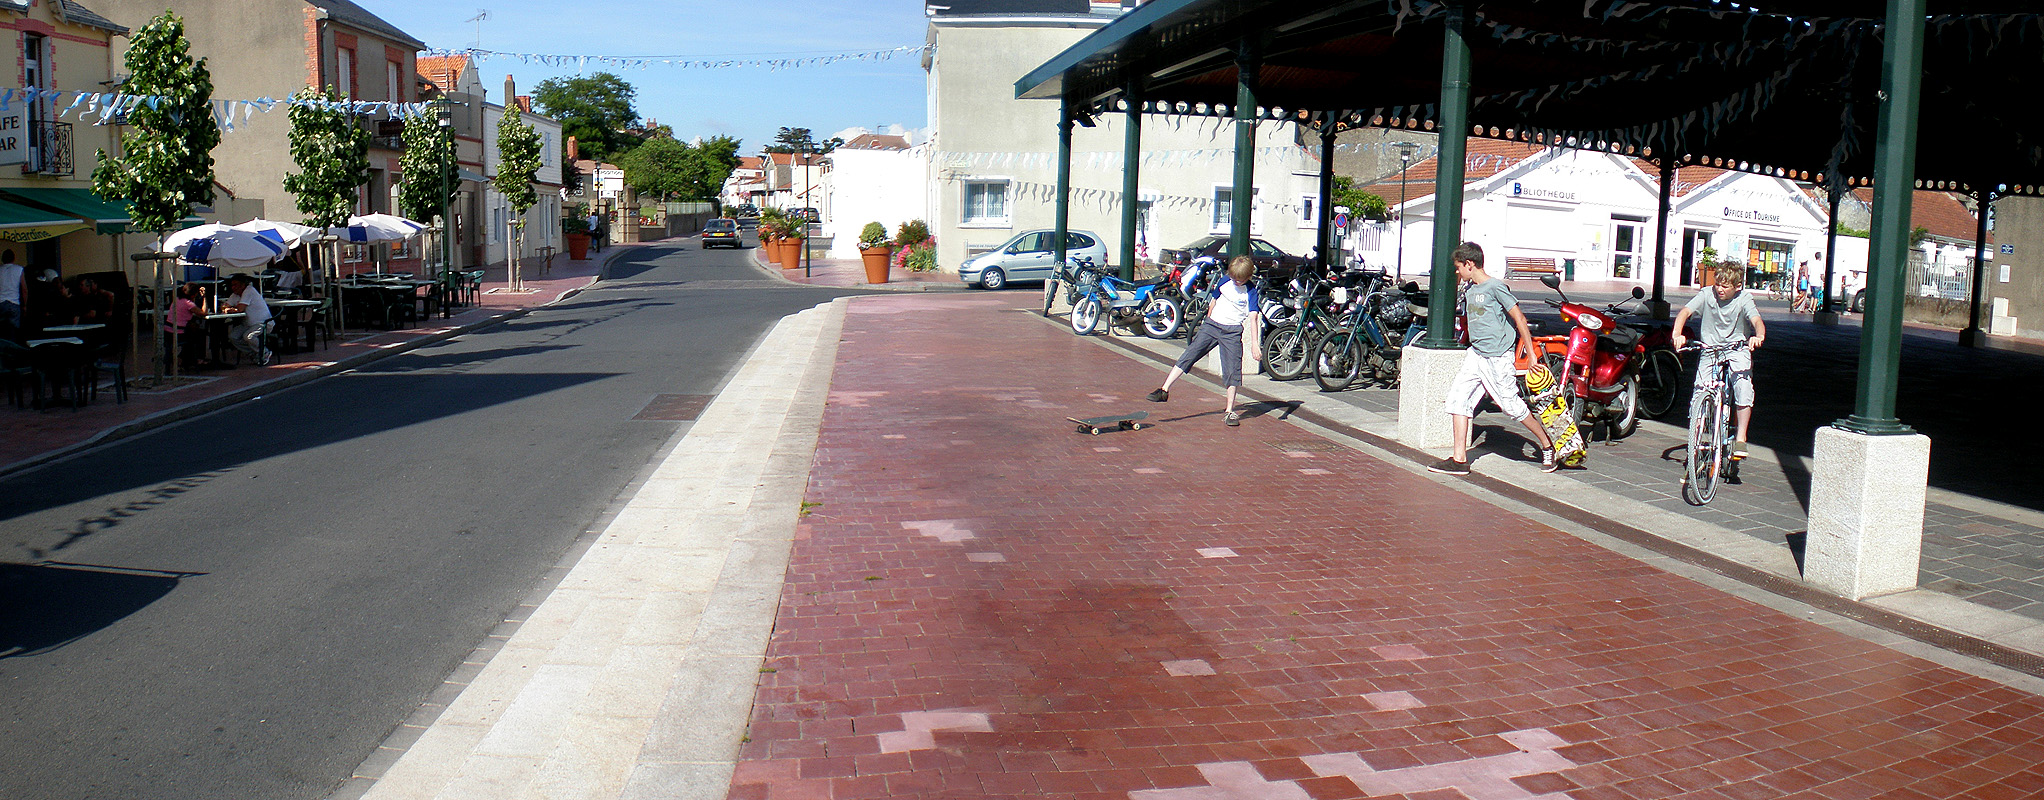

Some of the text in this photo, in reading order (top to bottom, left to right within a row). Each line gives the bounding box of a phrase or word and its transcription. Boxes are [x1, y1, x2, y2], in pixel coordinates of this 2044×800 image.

[1723, 206, 1780, 223] OFFICE DE TOURISME
